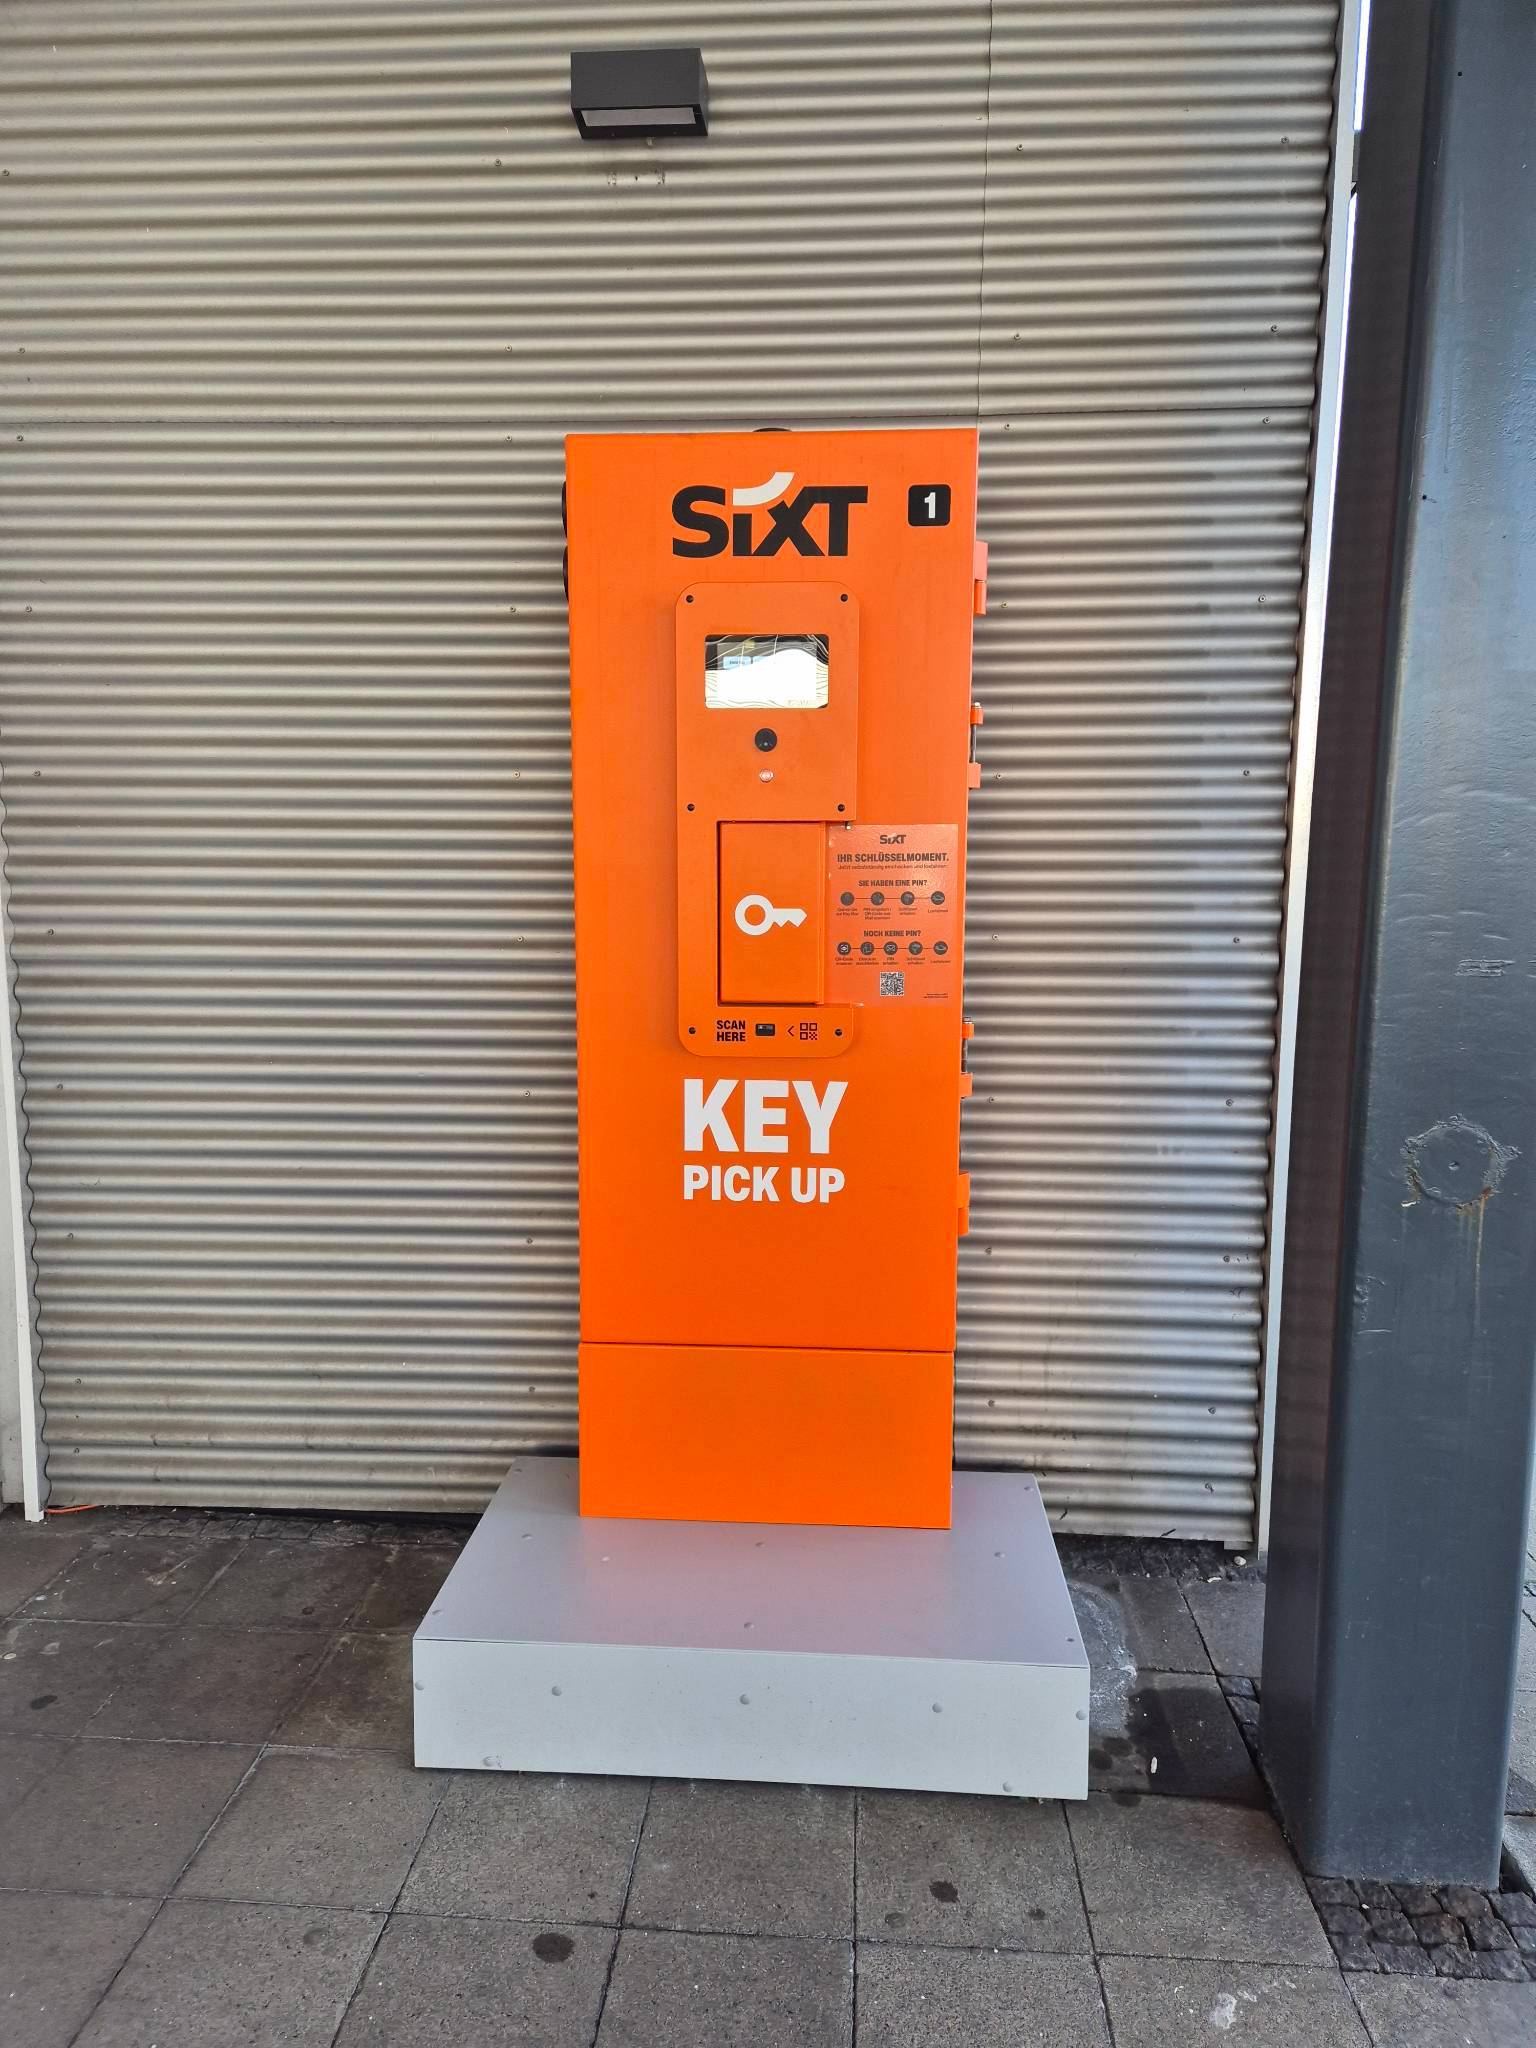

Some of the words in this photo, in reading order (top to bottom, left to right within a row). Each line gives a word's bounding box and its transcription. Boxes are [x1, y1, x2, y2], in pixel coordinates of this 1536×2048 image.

[924, 491, 936, 519] 1
[837, 853, 852, 863] IHR
[855, 852, 949, 863] SCHLÜSSELMOMENT.
[716, 1020, 746, 1030] SCAN
[716, 1031, 746, 1042] HERE
[684, 1078, 849, 1154] KEY
[683, 1164, 780, 1202] PICK
[791, 1166, 846, 1204] UP
